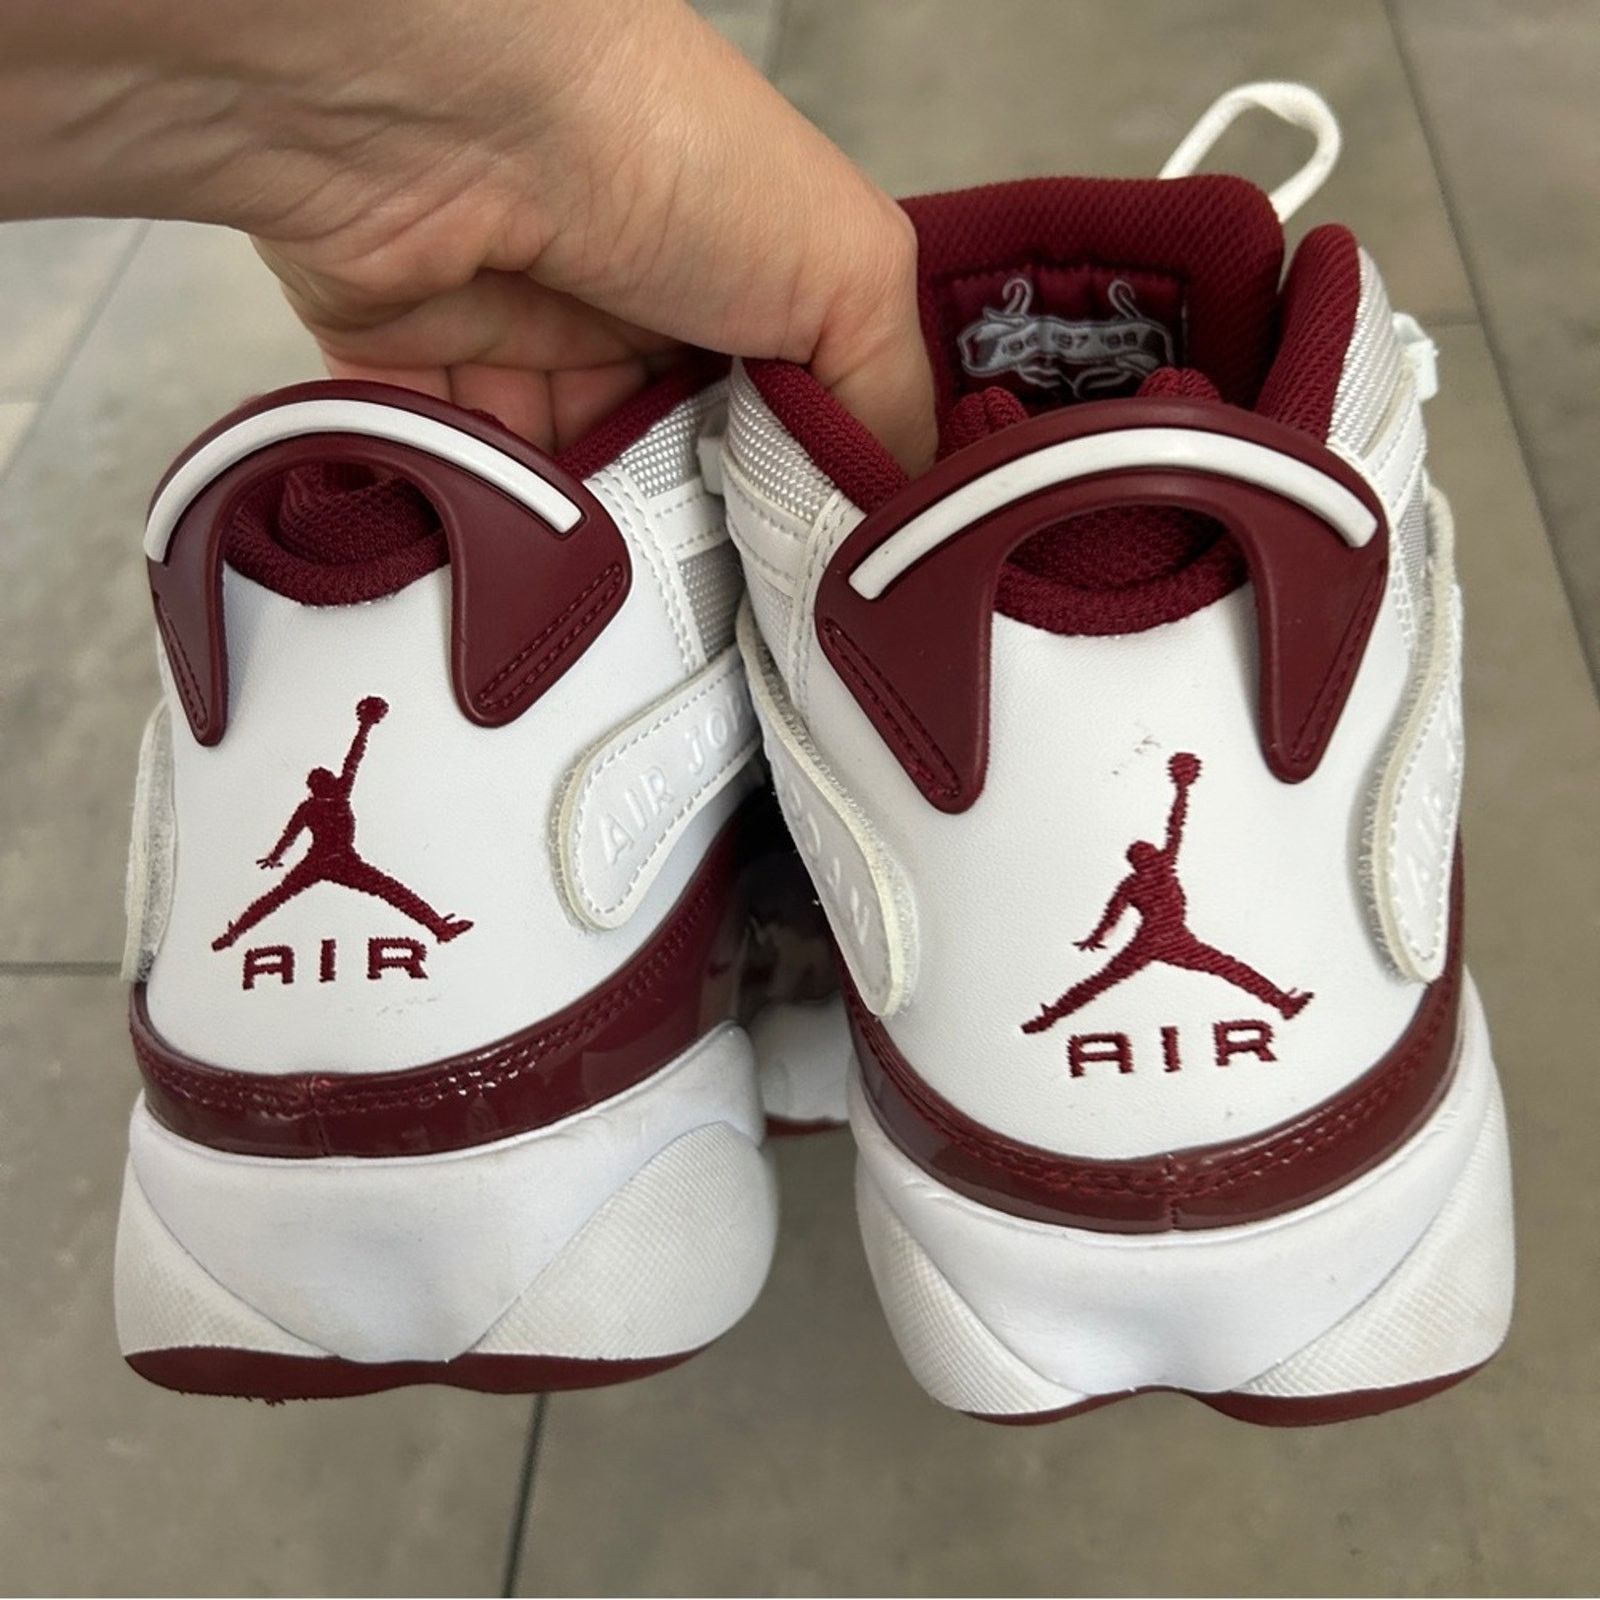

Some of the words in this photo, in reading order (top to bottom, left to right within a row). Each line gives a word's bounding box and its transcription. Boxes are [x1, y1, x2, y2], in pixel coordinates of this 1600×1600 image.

[598, 765, 676, 866] AIR
[242, 936, 429, 989] AIR
[1067, 1019, 1278, 1078] AIR
